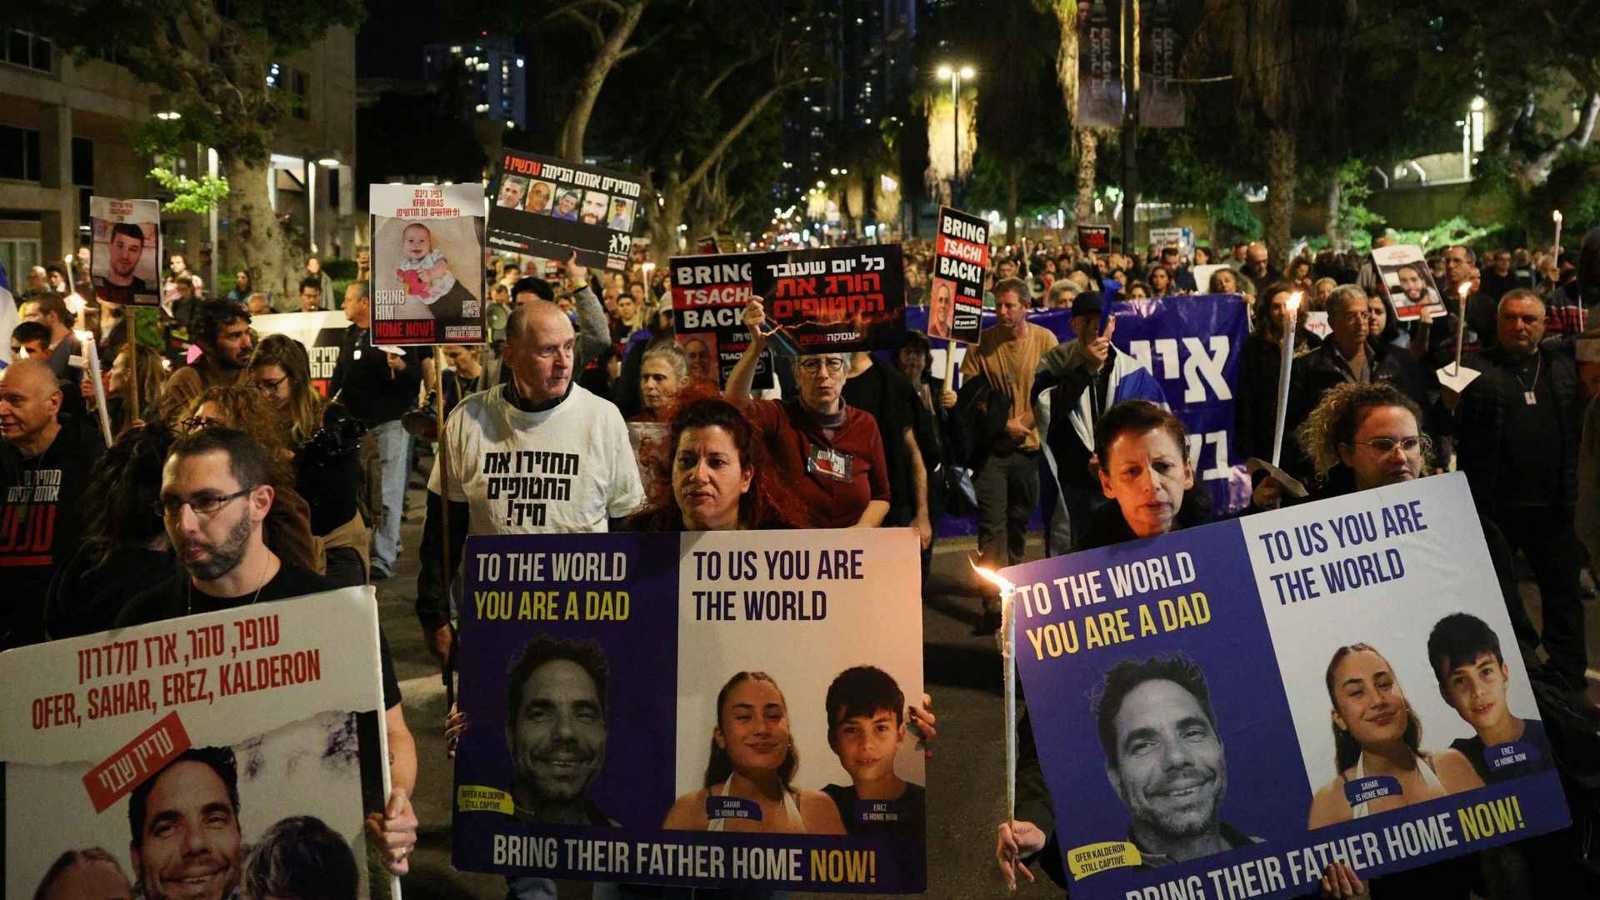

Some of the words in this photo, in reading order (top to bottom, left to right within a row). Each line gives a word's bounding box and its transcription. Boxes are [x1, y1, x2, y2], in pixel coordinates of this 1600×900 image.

[541, 163, 574, 183] הביתה
[574, 170, 602, 189] אותם
[601, 176, 640, 198] מחזירים
[943, 215, 986, 244] BRING
[861, 255, 885, 272] כל
[944, 239, 982, 263] TSACHI
[767, 261, 826, 278] שעובר
[832, 258, 857, 273] יום
[940, 256, 982, 284] BACK!
[375, 289, 405, 305] BRING
[684, 287, 753, 306] TSACH
[776, 277, 816, 297] את
[825, 272, 881, 295] הורג
[375, 305, 395, 320] HIM
[774, 293, 885, 318] החטופים
[375, 320, 402, 337] HOME
[406, 320, 434, 337] NOW!
[483, 452, 512, 474] את
[515, 450, 579, 476] תחזירו
[487, 477, 571, 501] החטופים
[506, 500, 547, 527] מיד!
[1259, 530, 1292, 565] TO
[1299, 524, 1328, 557] US
[1331, 514, 1377, 551] YOU
[1383, 500, 1428, 539] ARE
[477, 552, 500, 582] TO
[506, 552, 546, 582] THE
[551, 551, 627, 582] WORLD
[693, 551, 720, 581] TO
[729, 551, 758, 581] US
[764, 550, 809, 581] YOU
[816, 550, 865, 580] ARE
[1270, 569, 1319, 606] THE
[1321, 549, 1405, 594] WORLD
[1020, 583, 1050, 619] TO
[1053, 573, 1104, 612] THE
[1107, 551, 1196, 599] WORLD
[474, 591, 513, 621] YOU
[519, 591, 557, 621] ARE
[563, 591, 579, 621] A
[585, 590, 630, 621] DAD
[692, 591, 736, 621] THE
[743, 590, 827, 621] WORLD
[231, 614, 280, 659] עופר,
[1026, 620, 1079, 661] YOU
[1085, 610, 1134, 649] ARE
[1139, 604, 1157, 638] A
[1158, 592, 1212, 632] DAD
[145, 633, 178, 669] ארז
[184, 623, 224, 668] סהר,
[77, 640, 138, 686] קלדרון
[32, 692, 82, 730] OFER,
[88, 679, 157, 720] SAHAR,
[163, 667, 214, 708] EREZ,
[220, 649, 321, 697] KALDERON
[133, 727, 175, 774] עדיין
[99, 753, 137, 793] שבוי
[494, 834, 558, 870] BRING
[564, 839, 629, 873] THEIR
[636, 843, 726, 878] FATHER
[732, 847, 803, 881] HOME
[810, 850, 877, 883] NOW!
[1075, 850, 1092, 863] OFER
[1092, 843, 1126, 859] KALDERON
[1207, 856, 1286, 900] THEIR
[1287, 829, 1380, 884] FATHER
[1383, 813, 1458, 861] HOME
[1459, 795, 1524, 842] NOW!
[1080, 860, 1098, 874] STILL
[1099, 855, 1126, 871] CAPTIVE
